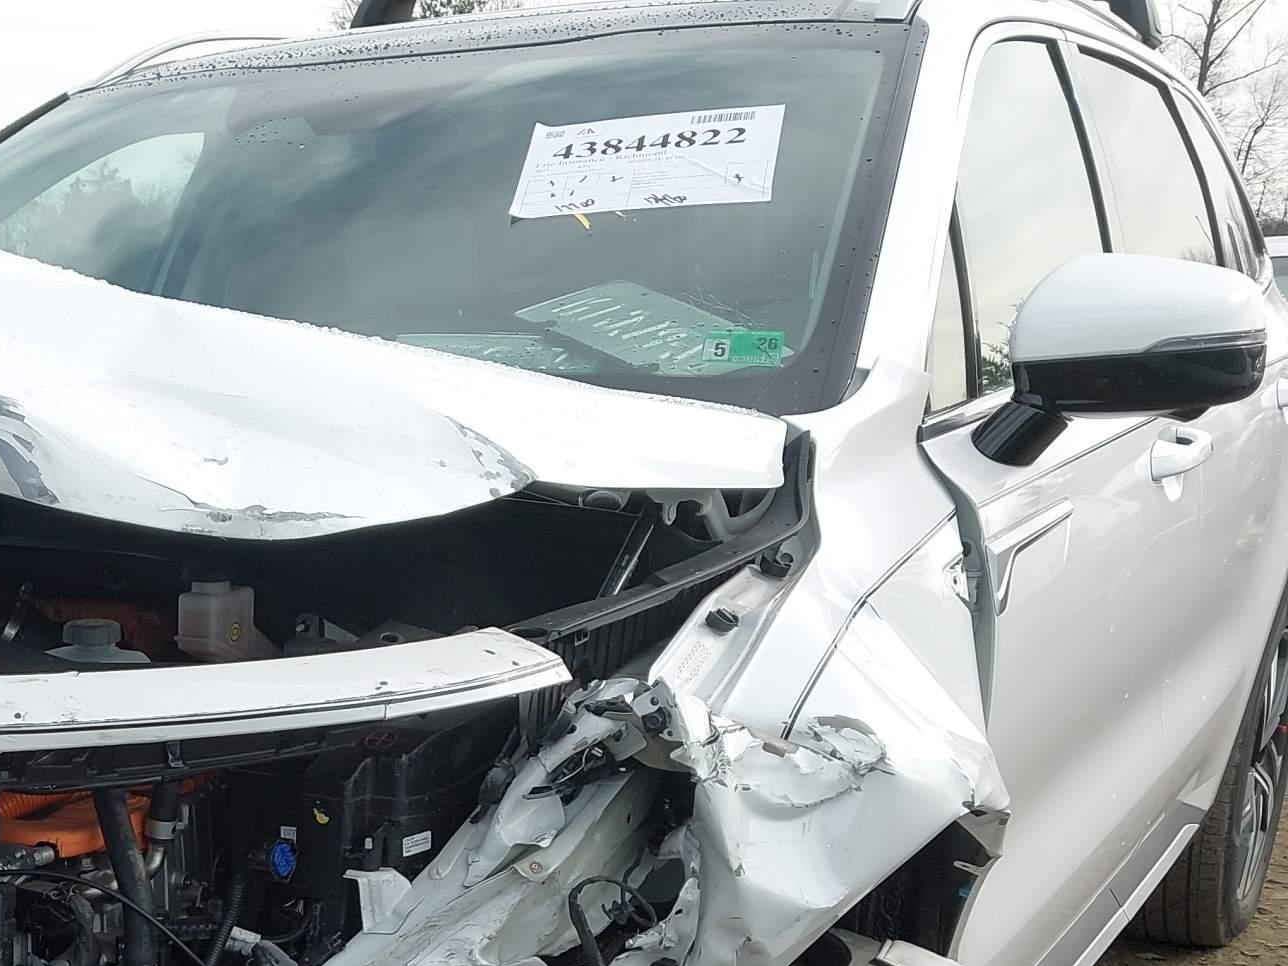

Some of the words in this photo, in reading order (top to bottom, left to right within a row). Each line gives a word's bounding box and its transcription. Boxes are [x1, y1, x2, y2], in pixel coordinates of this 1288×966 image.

[552, 127, 747, 160] 43844822
[713, 342, 726, 358] 5
[756, 337, 778, 350] 26
